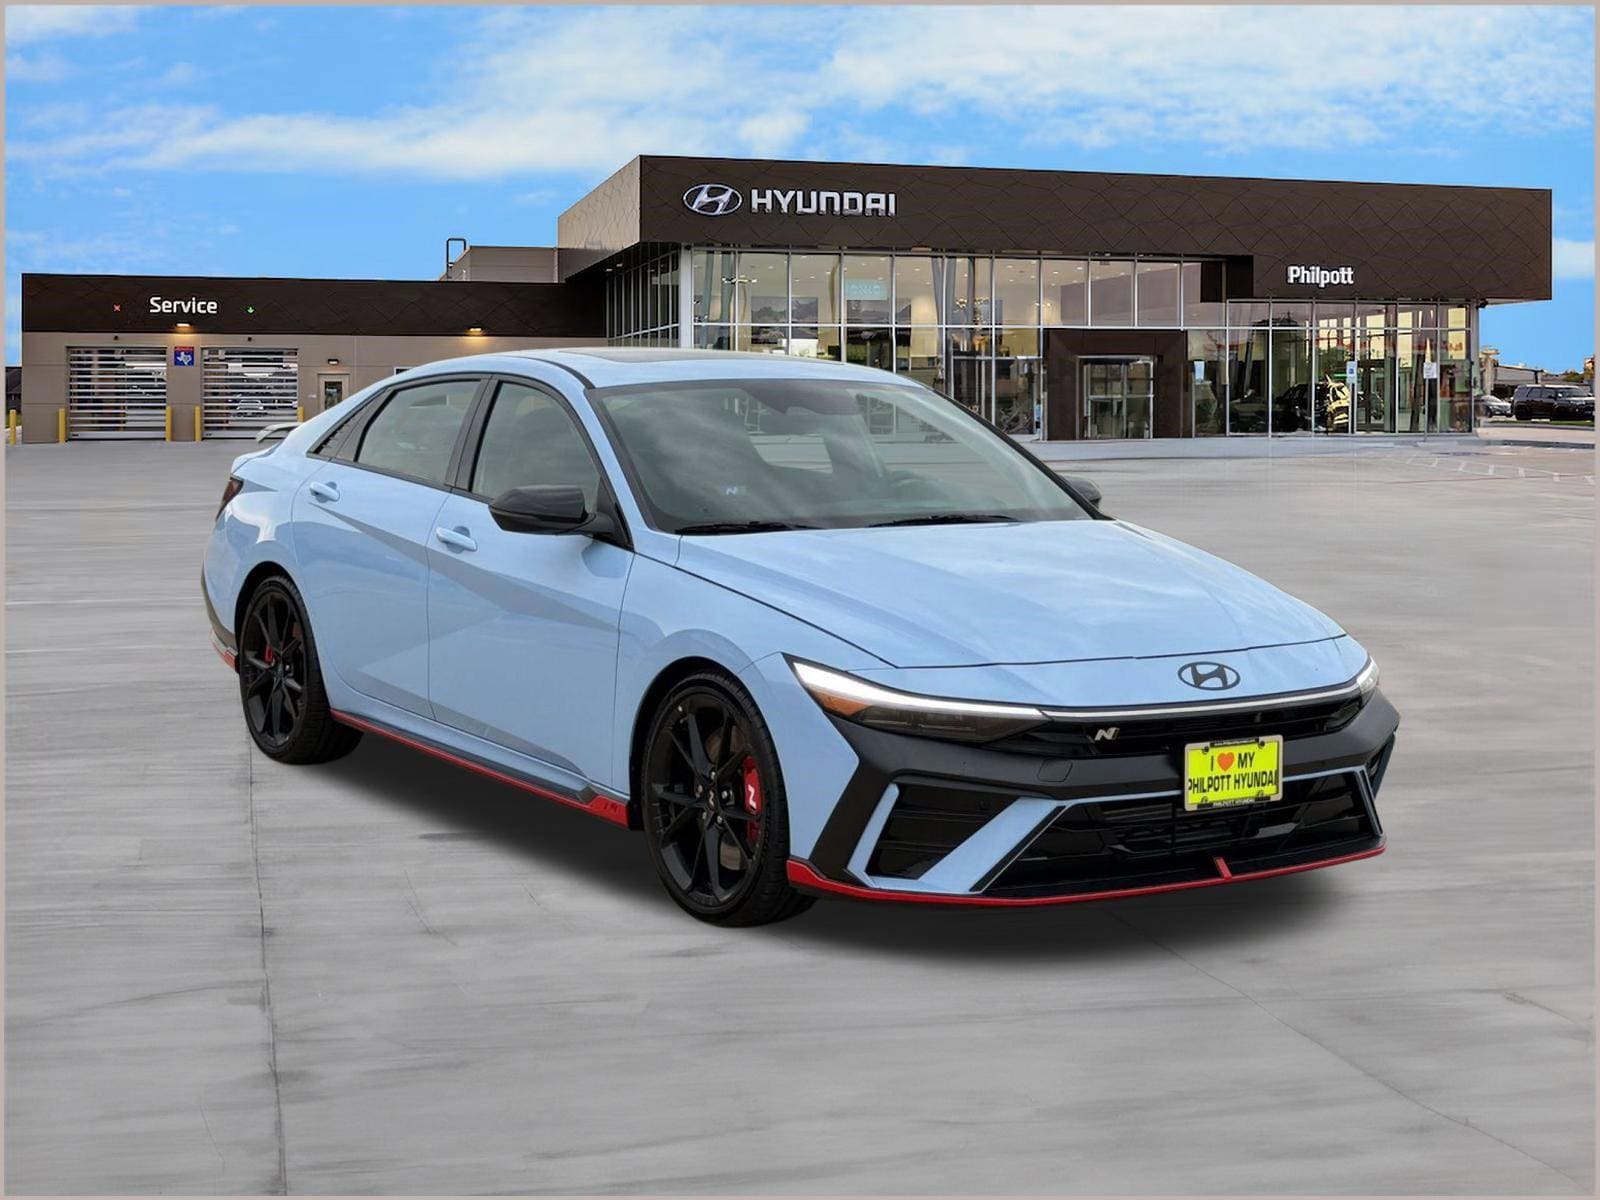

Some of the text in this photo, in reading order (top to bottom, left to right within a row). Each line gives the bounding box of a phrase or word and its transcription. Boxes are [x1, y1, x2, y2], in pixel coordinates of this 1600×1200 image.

[751, 188, 896, 216] HYUNDAI
[1287, 265, 1354, 288] Philpott
[149, 296, 218, 314] Service
[1210, 752, 1255, 771] I MY
